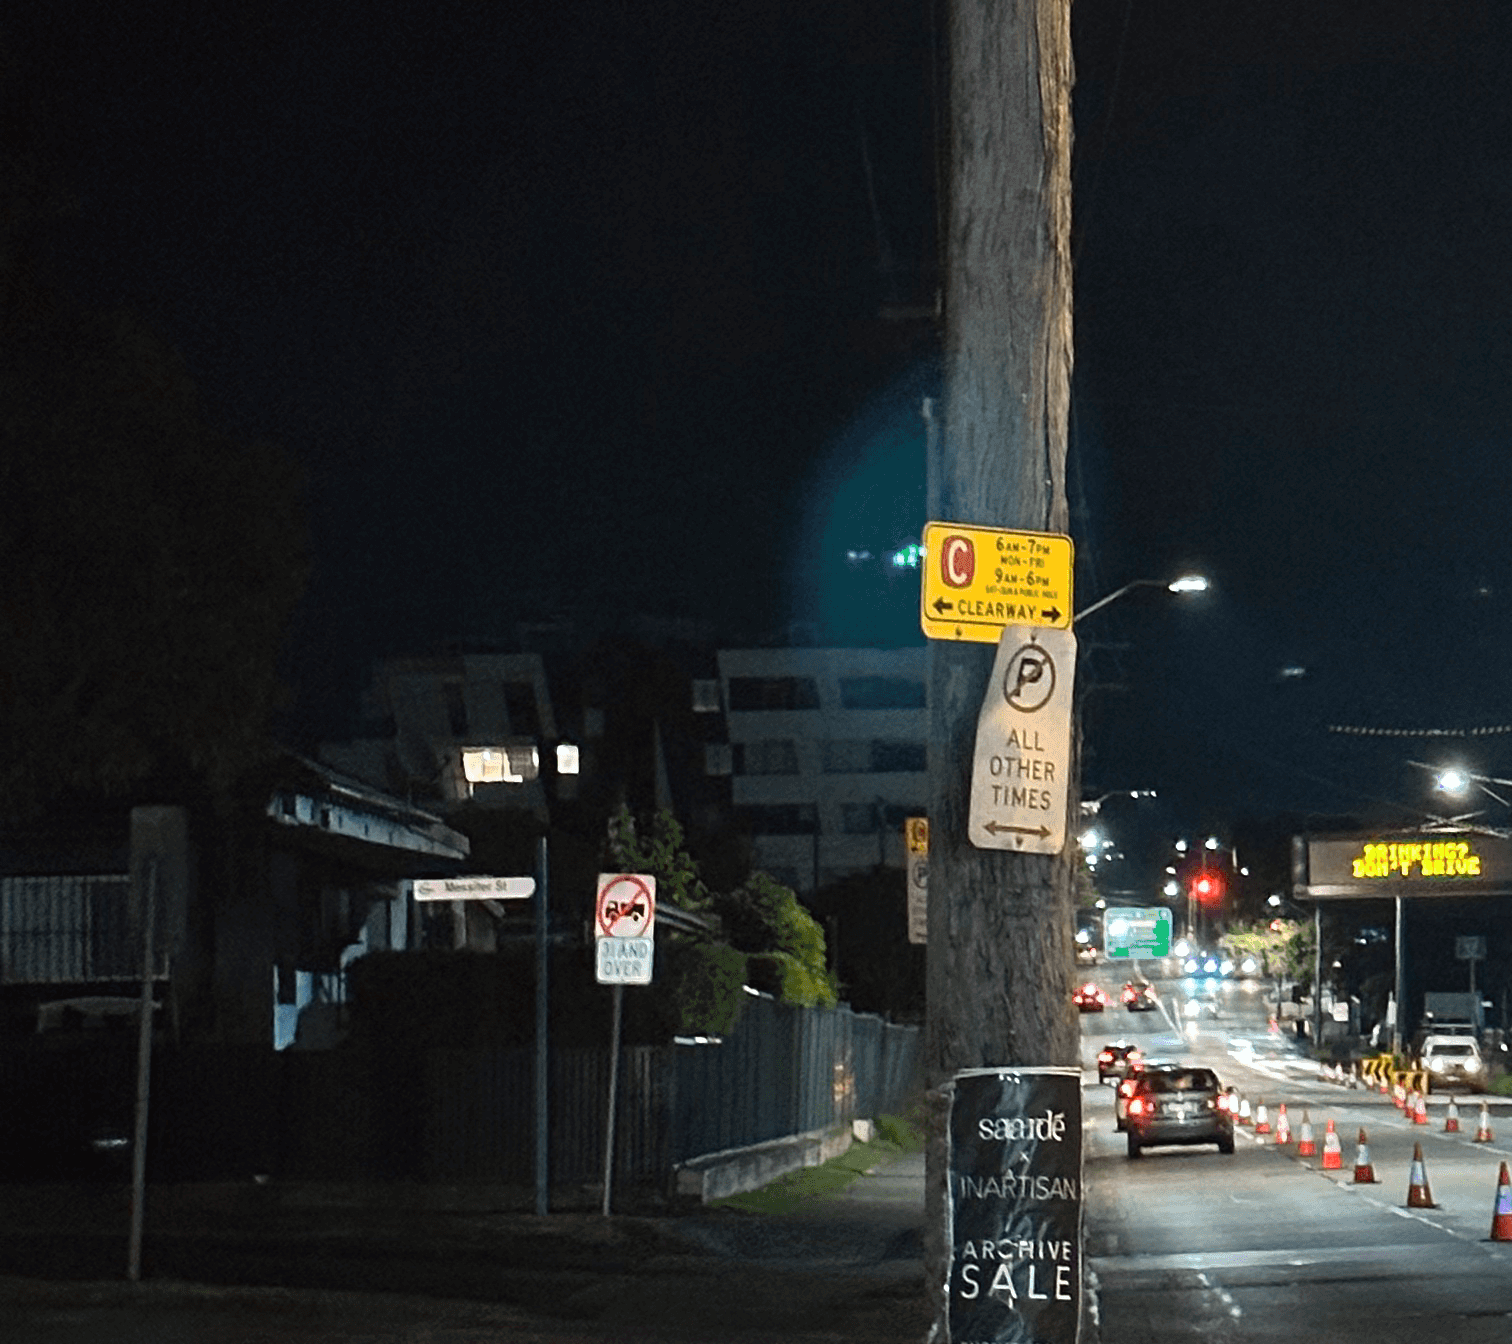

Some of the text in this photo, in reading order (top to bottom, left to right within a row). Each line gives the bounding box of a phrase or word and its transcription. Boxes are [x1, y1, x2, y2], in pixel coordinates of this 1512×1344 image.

[947, 538, 968, 586] C
[957, 598, 1037, 620] CLEARWAY
[1006, 729, 1045, 752] ALL
[989, 757, 1055, 782] OTHER
[991, 785, 1052, 810] TIMES
[617, 941, 648, 959] AND
[603, 959, 642, 977] OVER
[960, 1175, 1077, 1201] INARTISAN
[961, 1239, 1072, 1261] ARCHIVE
[959, 1263, 1072, 1301] SALE
